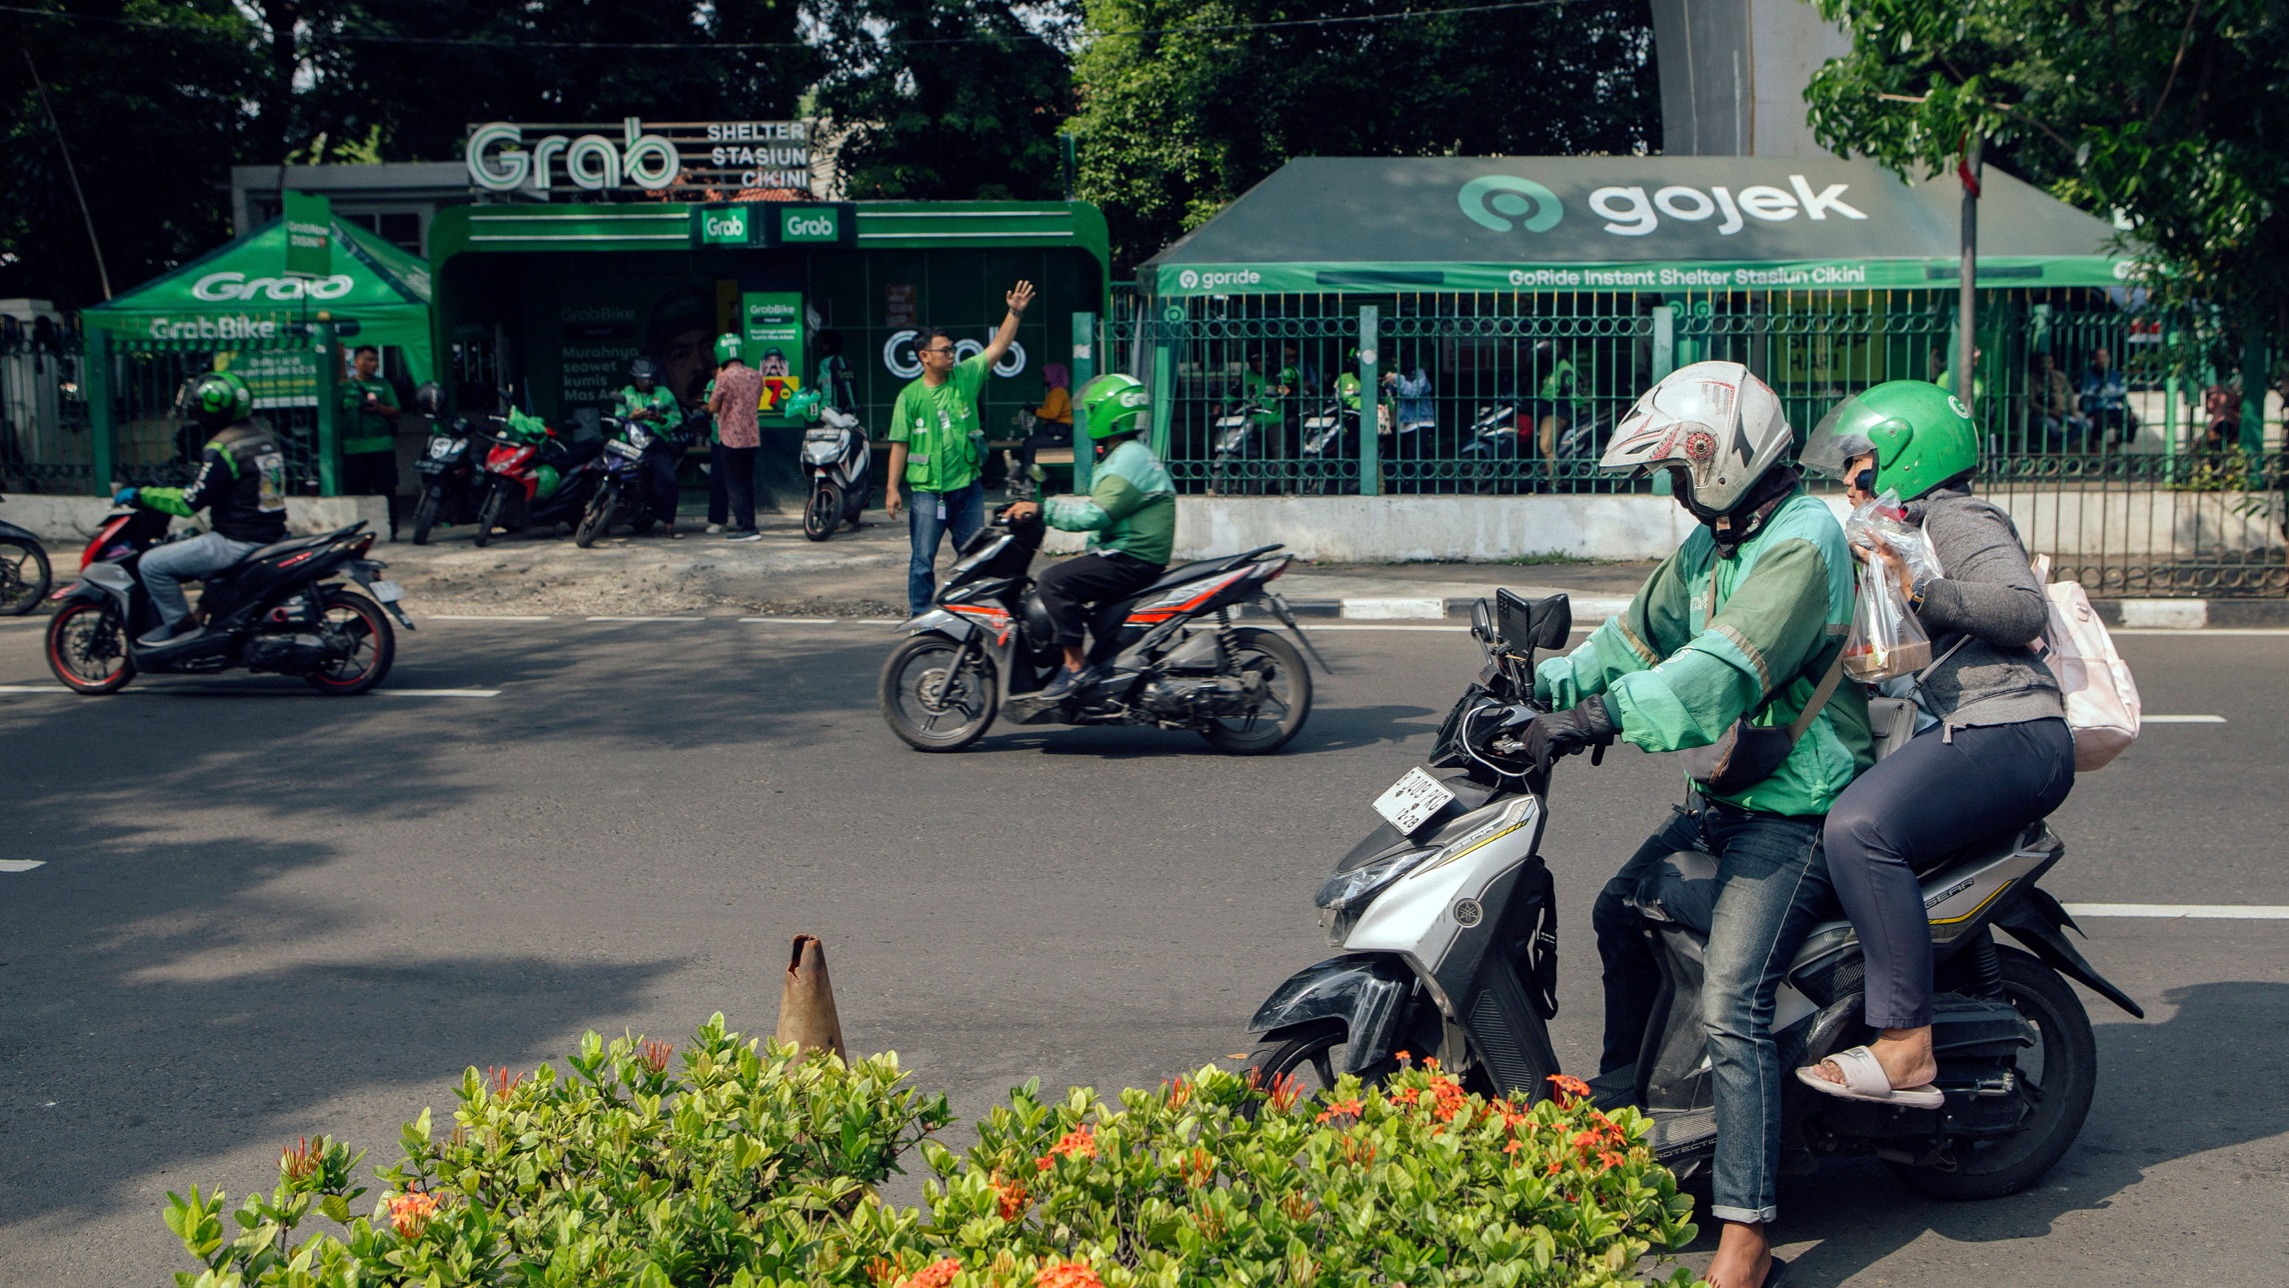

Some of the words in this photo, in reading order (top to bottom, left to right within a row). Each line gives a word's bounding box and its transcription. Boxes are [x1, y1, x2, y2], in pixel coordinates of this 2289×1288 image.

[707, 124, 806, 141] SHELTER
[466, 117, 679, 191] Grab
[712, 147, 807, 166] STASIUN
[741, 170, 808, 188] CIKINI
[1588, 174, 1868, 237] gojek
[707, 216, 744, 236] Grab
[787, 216, 833, 236] Grab
[1202, 269, 1261, 289] goride
[1508, 269, 1580, 287] GoRide
[1584, 268, 1656, 286] Instant
[1659, 267, 1732, 285] Shelter
[1735, 266, 1809, 285] Stasiun
[1811, 265, 1865, 283] Cikini
[750, 304, 795, 315] GrabBike
[151, 315, 276, 339] GrabBike
[561, 346, 639, 361] Murahnya
[883, 326, 1026, 379] Gab
[563, 361, 618, 374] seawet
[563, 374, 608, 387] kumis
[564, 388, 596, 402] Mas
[765, 379, 785, 405] 7
[1420, 788, 1449, 812] PKG
[1450, 826, 1495, 852] GEAR
[1924, 877, 1974, 909] GEAR
